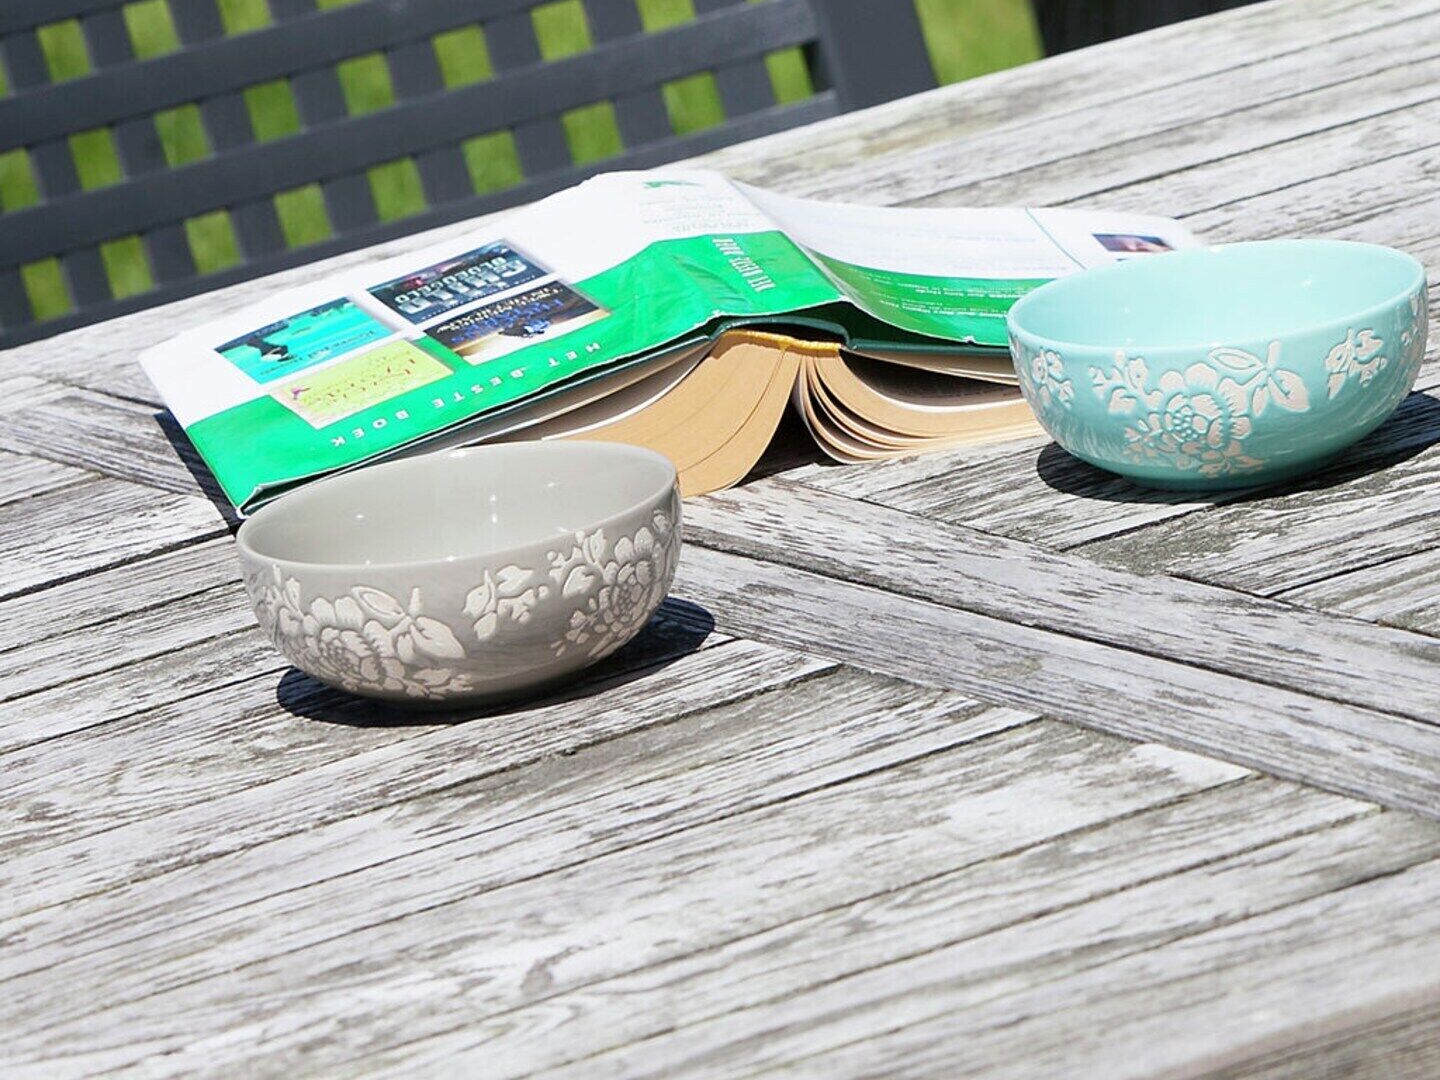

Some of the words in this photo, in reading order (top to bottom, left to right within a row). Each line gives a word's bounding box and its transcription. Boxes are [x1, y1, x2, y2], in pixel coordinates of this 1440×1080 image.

[546, 340, 601, 367] HET
[431, 368, 523, 411] BESTE
[330, 408, 411, 449] BOEK
